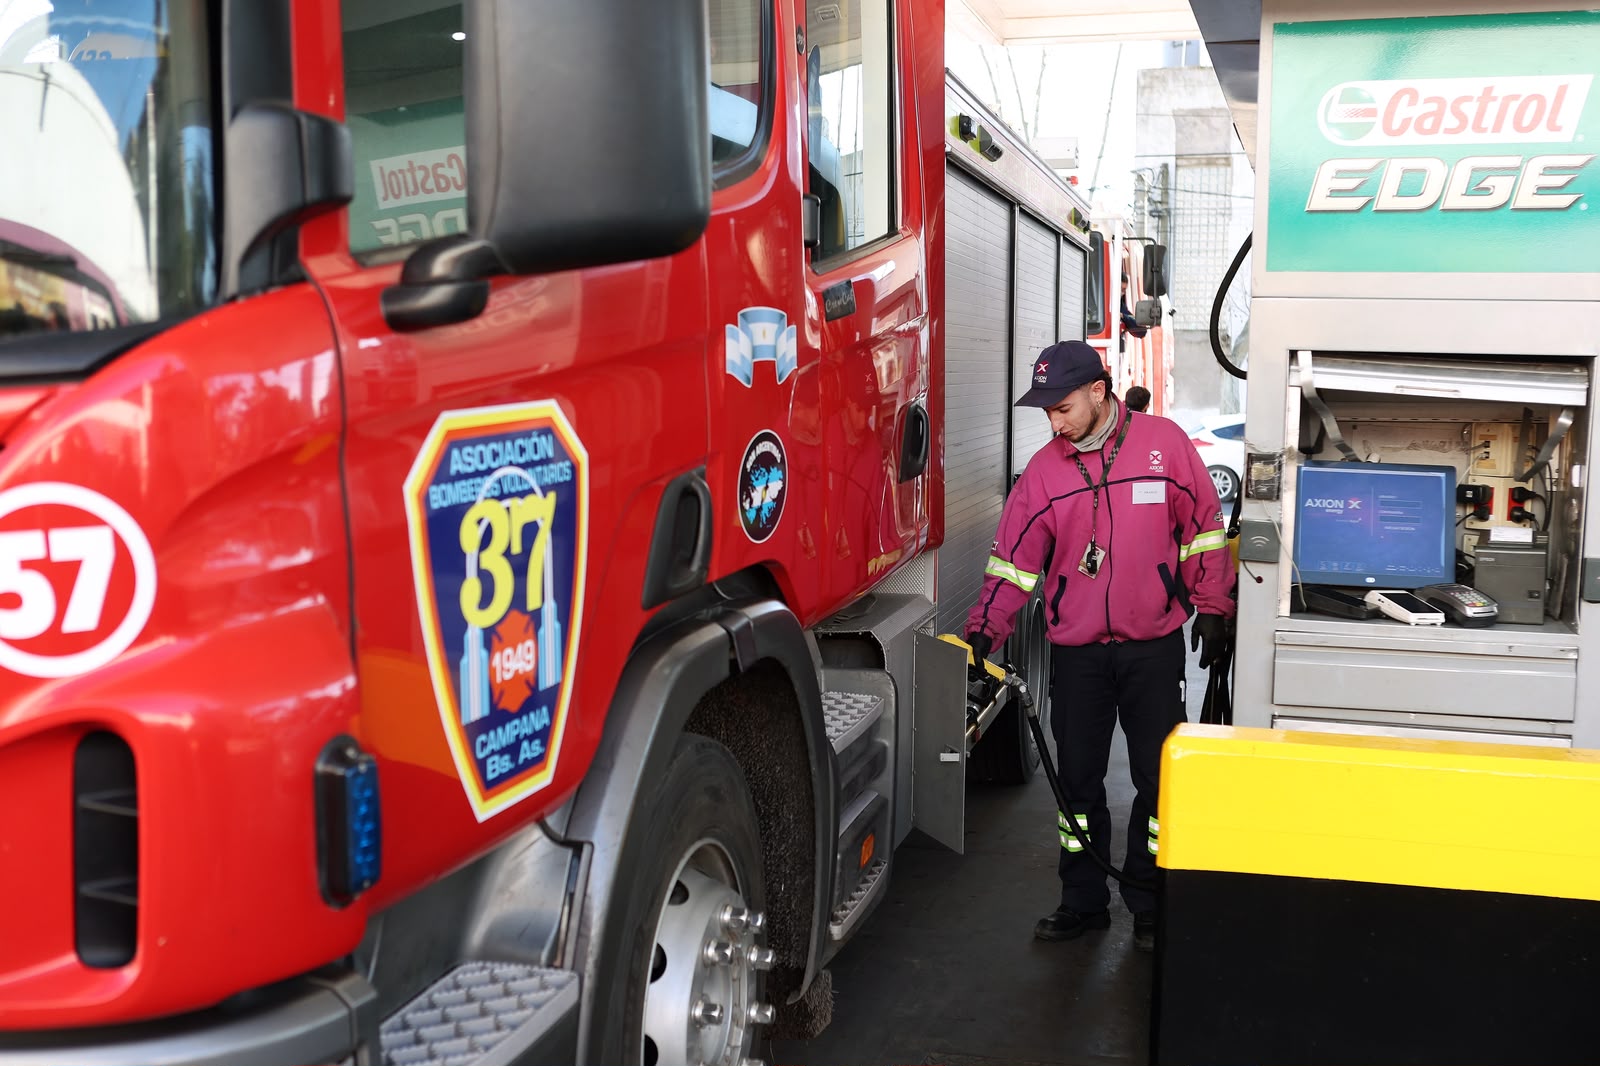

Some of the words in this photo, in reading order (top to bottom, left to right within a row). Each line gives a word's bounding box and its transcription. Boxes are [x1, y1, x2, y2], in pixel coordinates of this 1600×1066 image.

[1382, 84, 1569, 137] Castrol
[1304, 154, 1598, 213] EDGE
[450, 431, 554, 476] ASOCIACIÓN
[429, 475, 501, 509] BOMBEROS
[1304, 498, 1344, 508] AXION
[0, 525, 116, 640] 57
[459, 491, 557, 629] 37
[492, 639, 536, 684] 1949
[475, 705, 551, 760] CAMPANA
[486, 754, 515, 781] Bs.
[518, 739, 545, 765] As.
